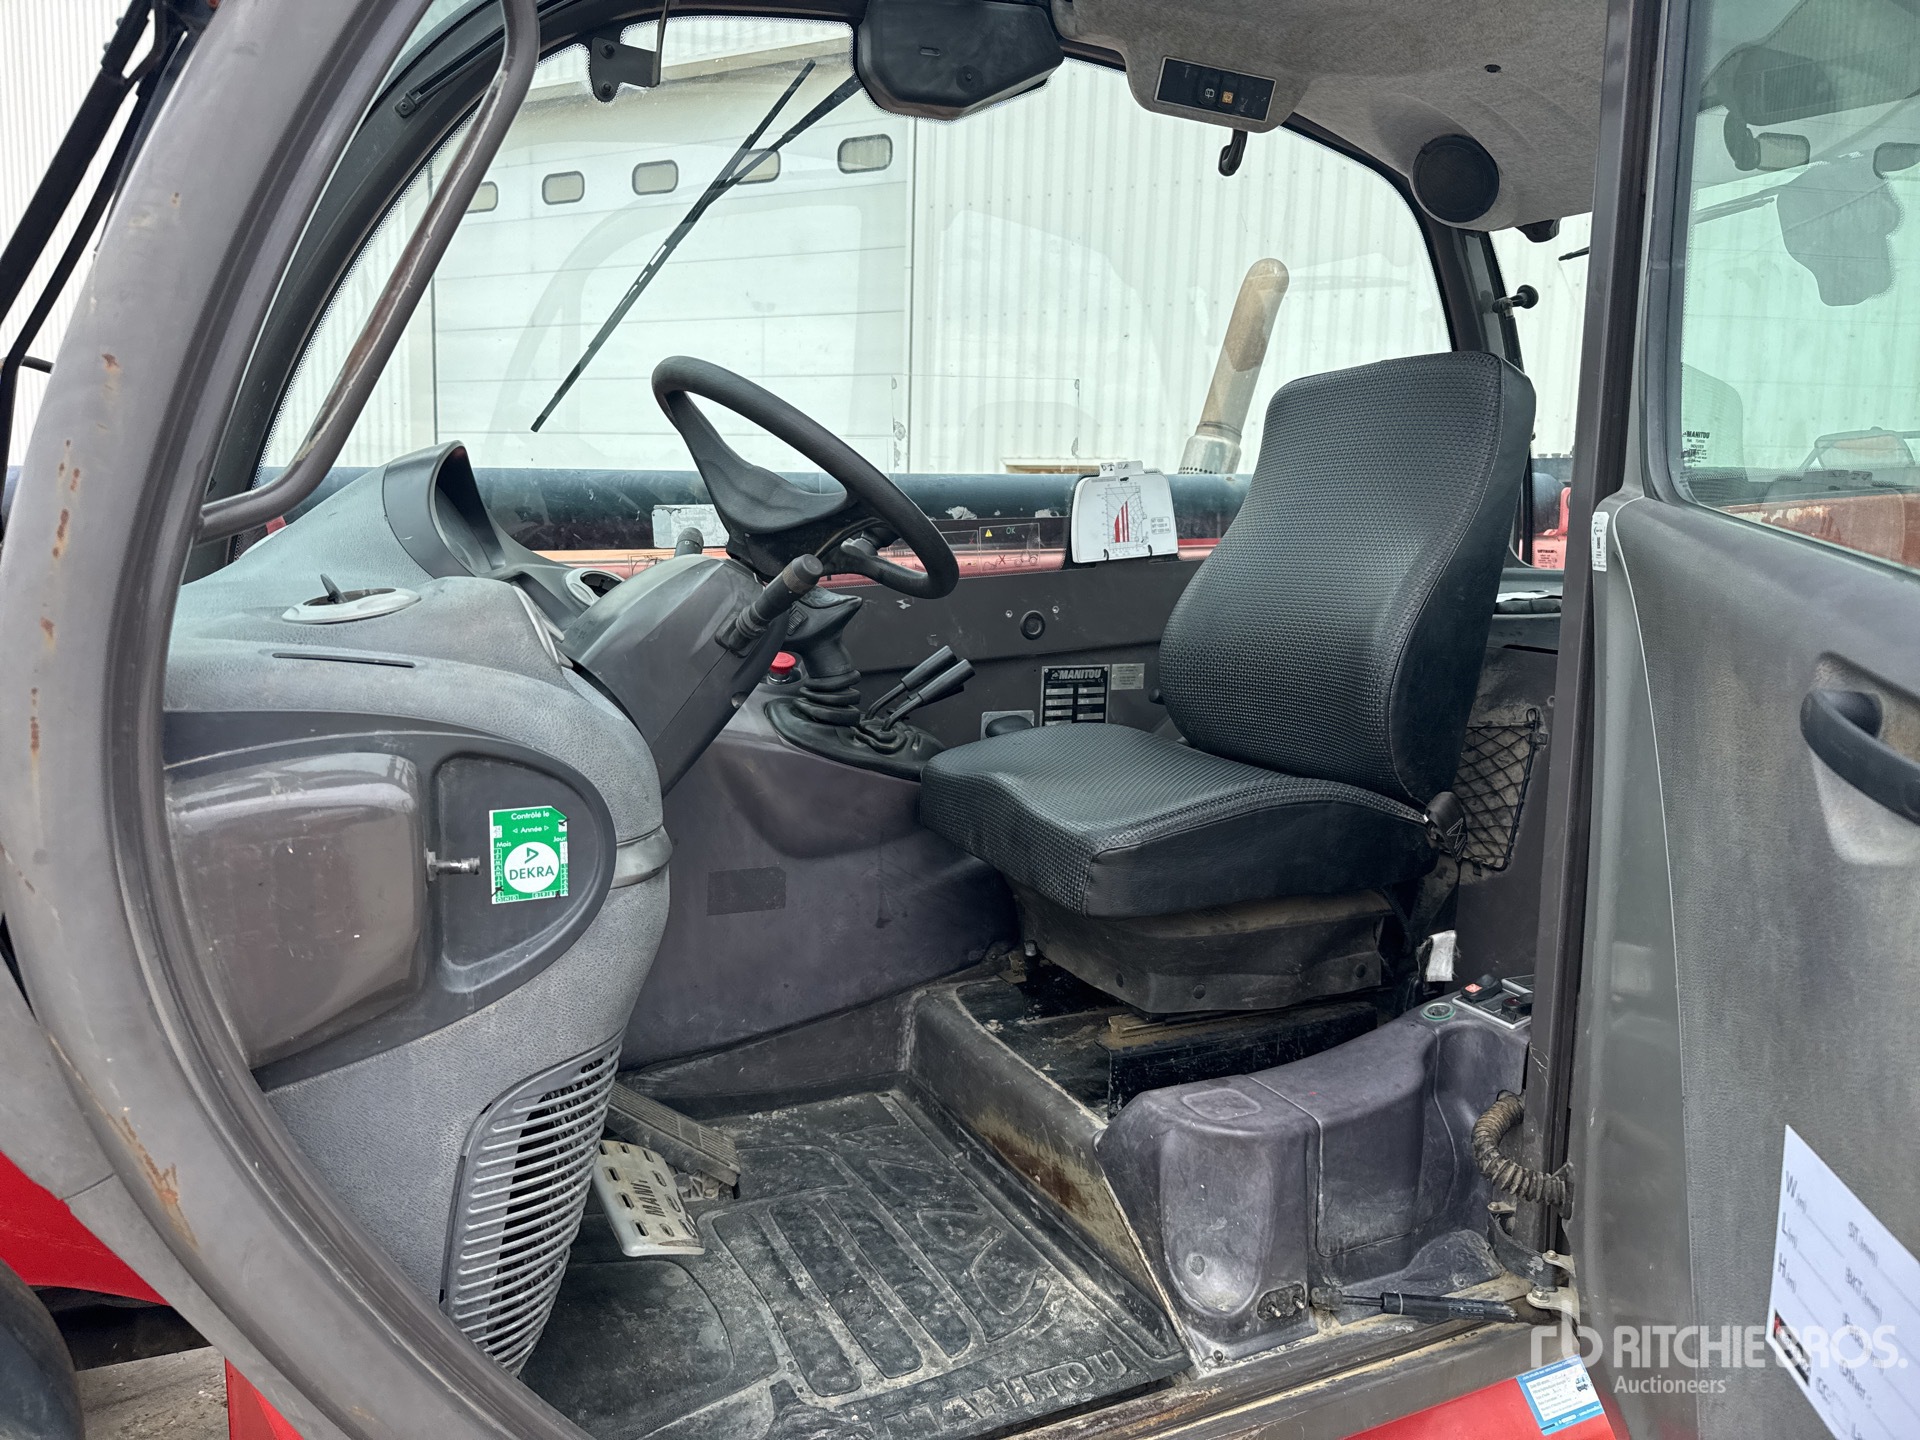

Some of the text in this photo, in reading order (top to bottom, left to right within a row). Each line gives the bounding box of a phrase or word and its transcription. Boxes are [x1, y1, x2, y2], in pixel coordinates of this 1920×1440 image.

[1687, 430, 1710, 439] MANITOU
[1005, 526, 1016, 535] OK
[1059, 669, 1101, 679] MANITOU
[510, 810, 550, 821] Contrôlé le
[520, 826, 543, 834] Année
[509, 865, 555, 880] DEKRA
[883, 1349, 1128, 1440] MANITOU
